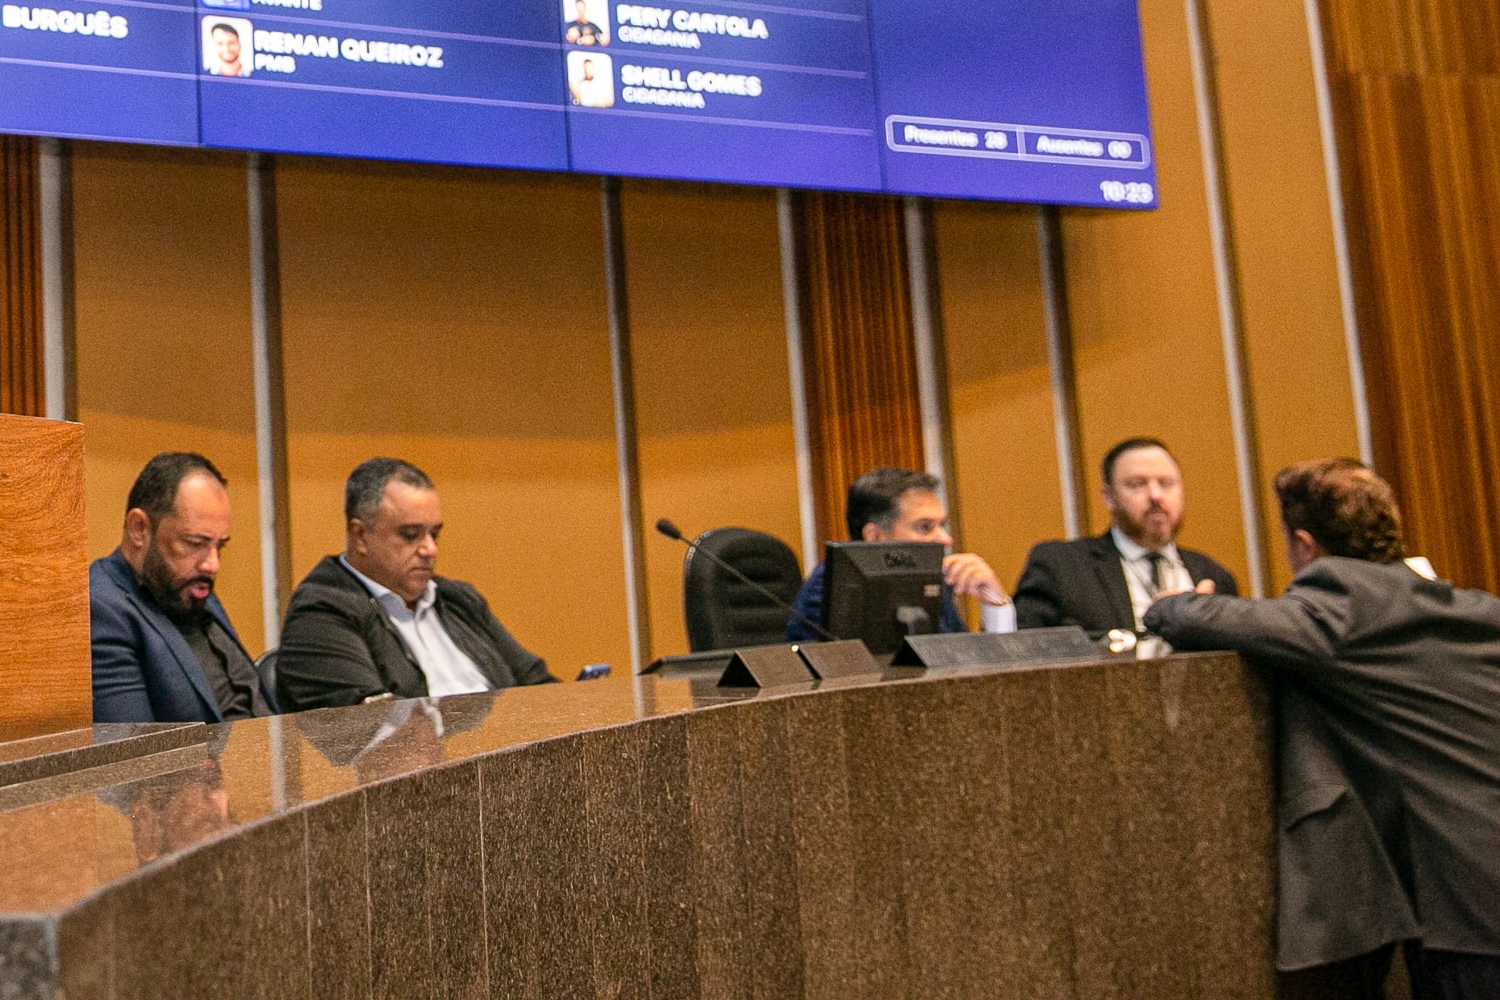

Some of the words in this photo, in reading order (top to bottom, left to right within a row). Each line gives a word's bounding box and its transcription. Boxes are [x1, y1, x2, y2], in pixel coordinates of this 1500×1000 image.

[2, 4, 128, 38] BURGUÊS
[617, 4, 671, 28] PERY
[672, 10, 768, 39] CARTOLA
[253, 30, 339, 58] RENAN
[341, 38, 444, 68] QUEIROZ
[621, 64, 687, 90] SHELL
[687, 71, 762, 96] GOMES
